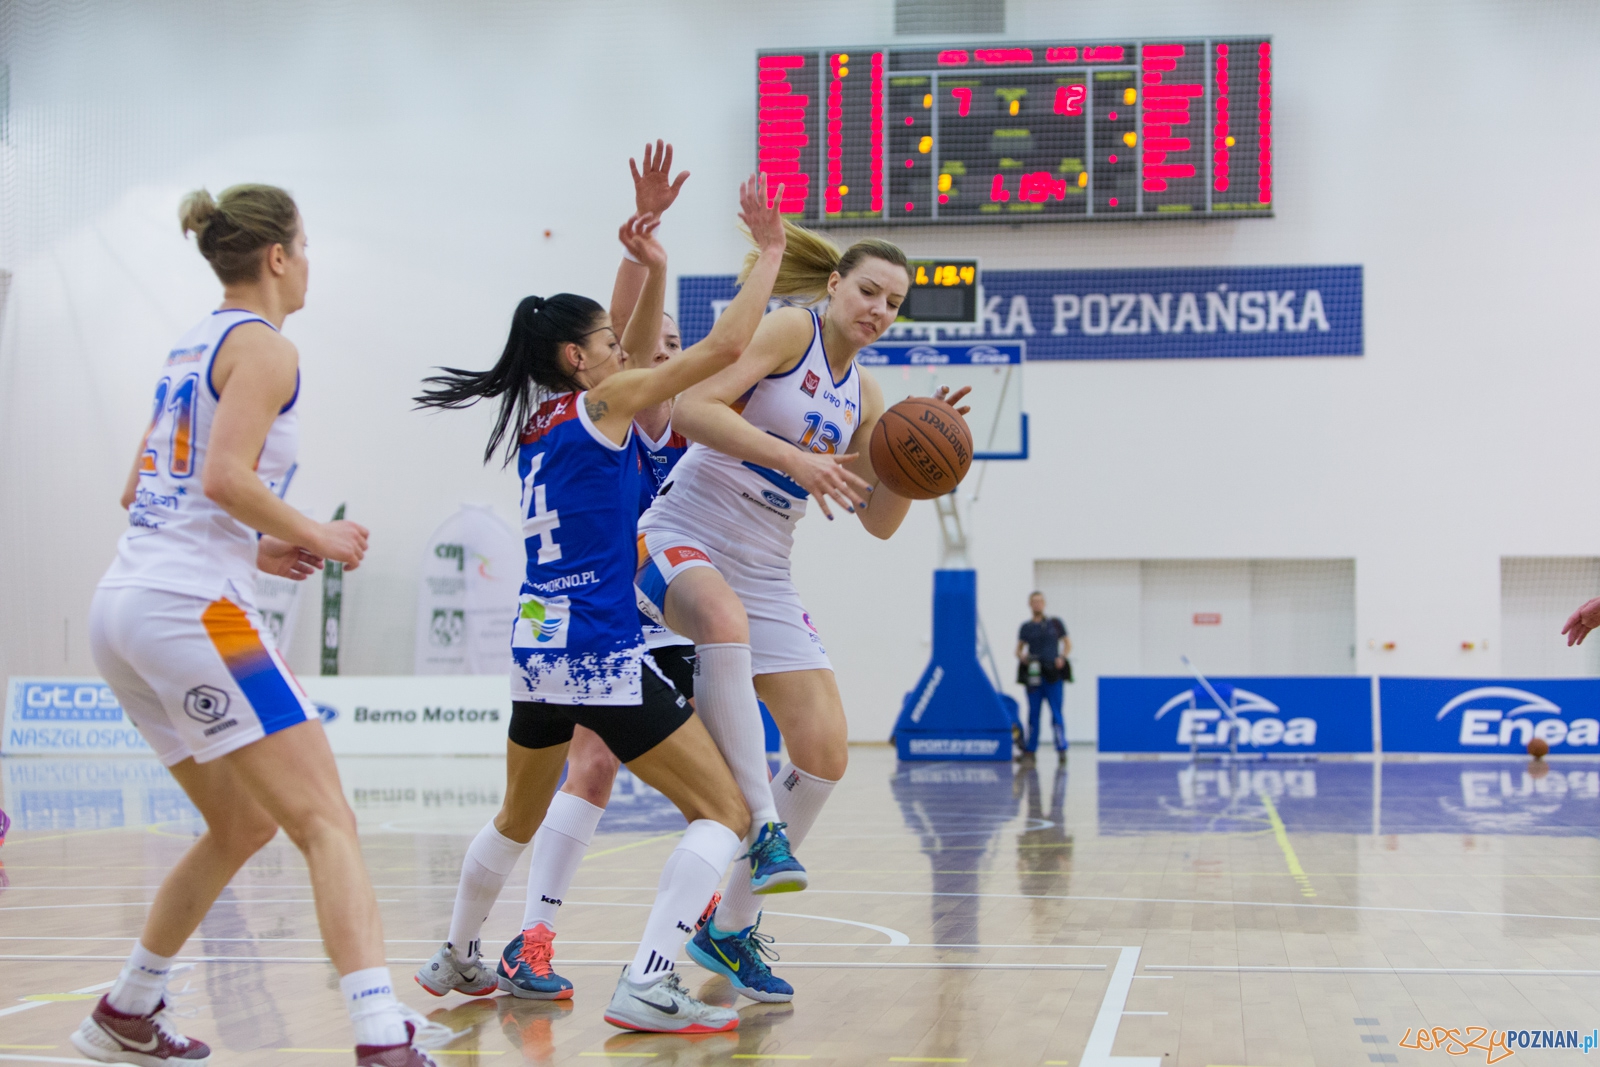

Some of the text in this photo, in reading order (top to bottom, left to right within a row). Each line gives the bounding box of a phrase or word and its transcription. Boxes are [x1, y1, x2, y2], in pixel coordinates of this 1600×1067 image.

[1051, 284, 1330, 336] POZNAŃSKA
[910, 352, 950, 364] Enea
[970, 351, 1011, 364] Enea
[798, 411, 842, 455] 13
[919, 409, 968, 467] SPALDING
[904, 435, 943, 480] TF-250
[766, 493, 788, 508] Ford
[353, 706, 500, 723] Bemo Motors
[1176, 708, 1318, 746] Enea
[1459, 709, 1600, 747] Enea
